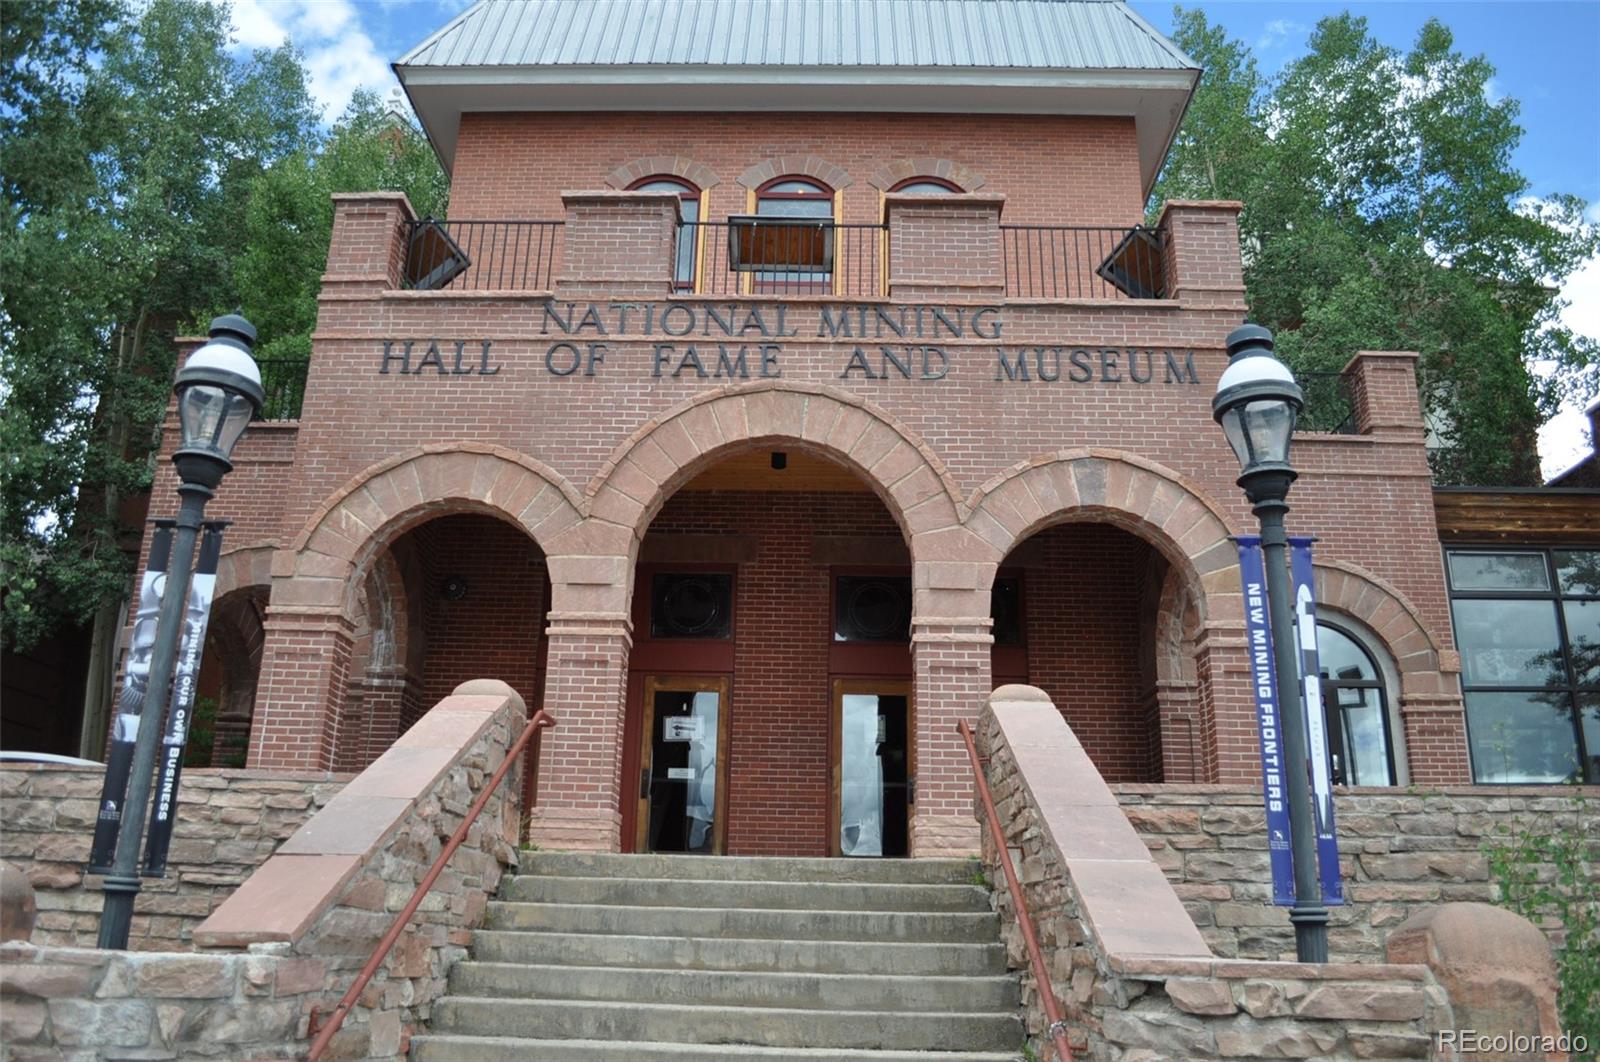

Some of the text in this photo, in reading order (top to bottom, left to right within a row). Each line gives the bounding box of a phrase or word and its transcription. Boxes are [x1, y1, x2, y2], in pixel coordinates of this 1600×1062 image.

[379, 340, 1200, 384] HALL OF FAME AND MUSEUM
[540, 302, 1003, 339] NATIONAL MINING
[158, 619, 203, 821] MINING OUR OWN BUSINESS
[1248, 583, 1282, 812] NEW MINING FRONTIERS
